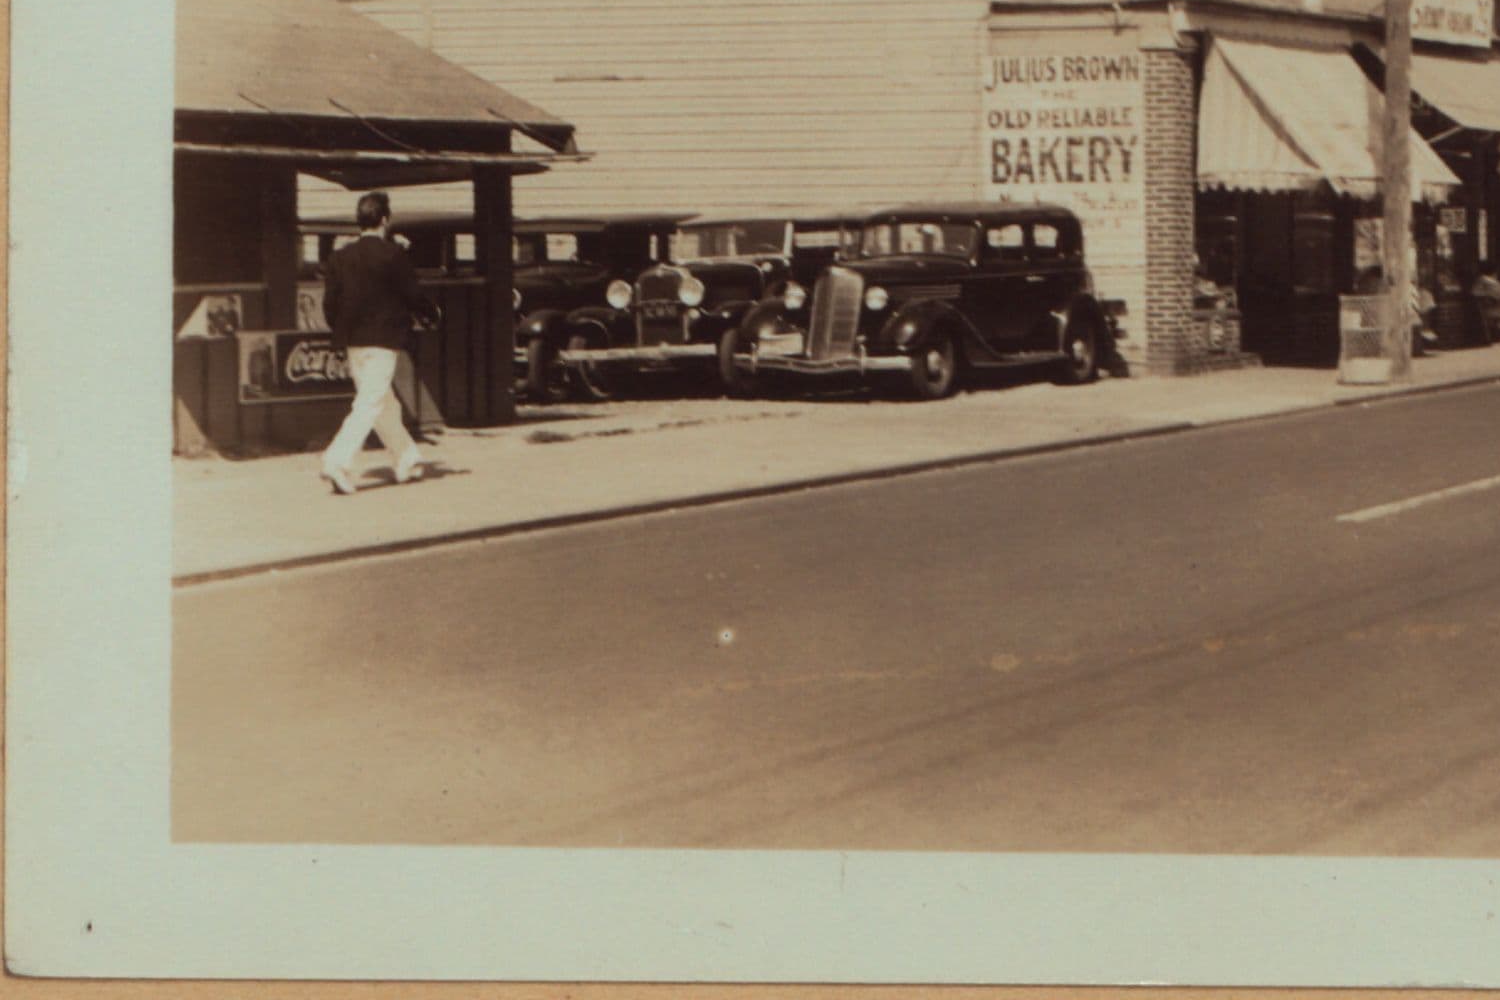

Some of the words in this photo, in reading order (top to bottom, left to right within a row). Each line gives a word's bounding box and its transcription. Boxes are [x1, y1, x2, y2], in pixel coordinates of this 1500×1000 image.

[985, 56, 1056, 91] JULIUS
[1062, 54, 1139, 83] BROWN
[987, 109, 1032, 129] OLD
[1037, 106, 1133, 129] RELIABLE
[990, 134, 1139, 185] BAKERY
